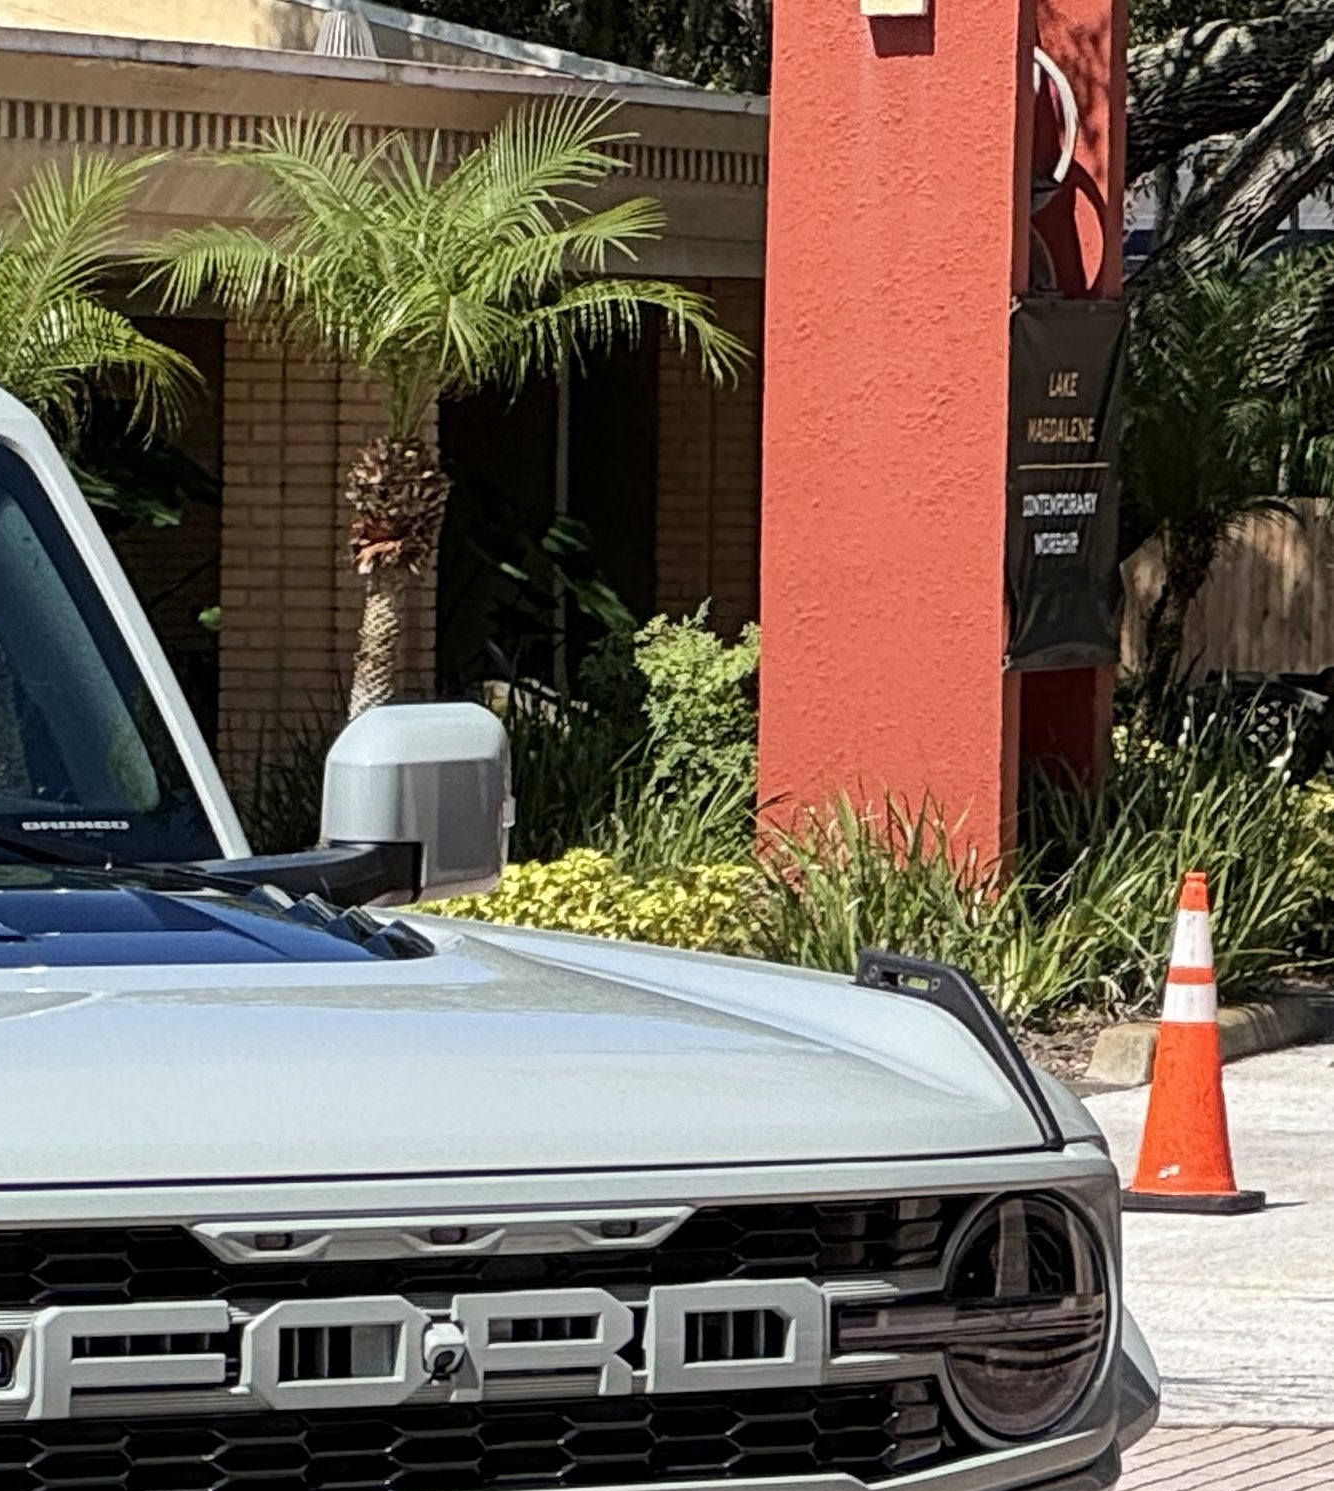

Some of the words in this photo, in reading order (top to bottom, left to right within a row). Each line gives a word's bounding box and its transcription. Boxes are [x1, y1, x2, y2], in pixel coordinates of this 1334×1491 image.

[1048, 371, 1079, 397] LAKE
[1027, 416, 1095, 443] MAGDALENE
[24, 1277, 829, 1420] FORD
